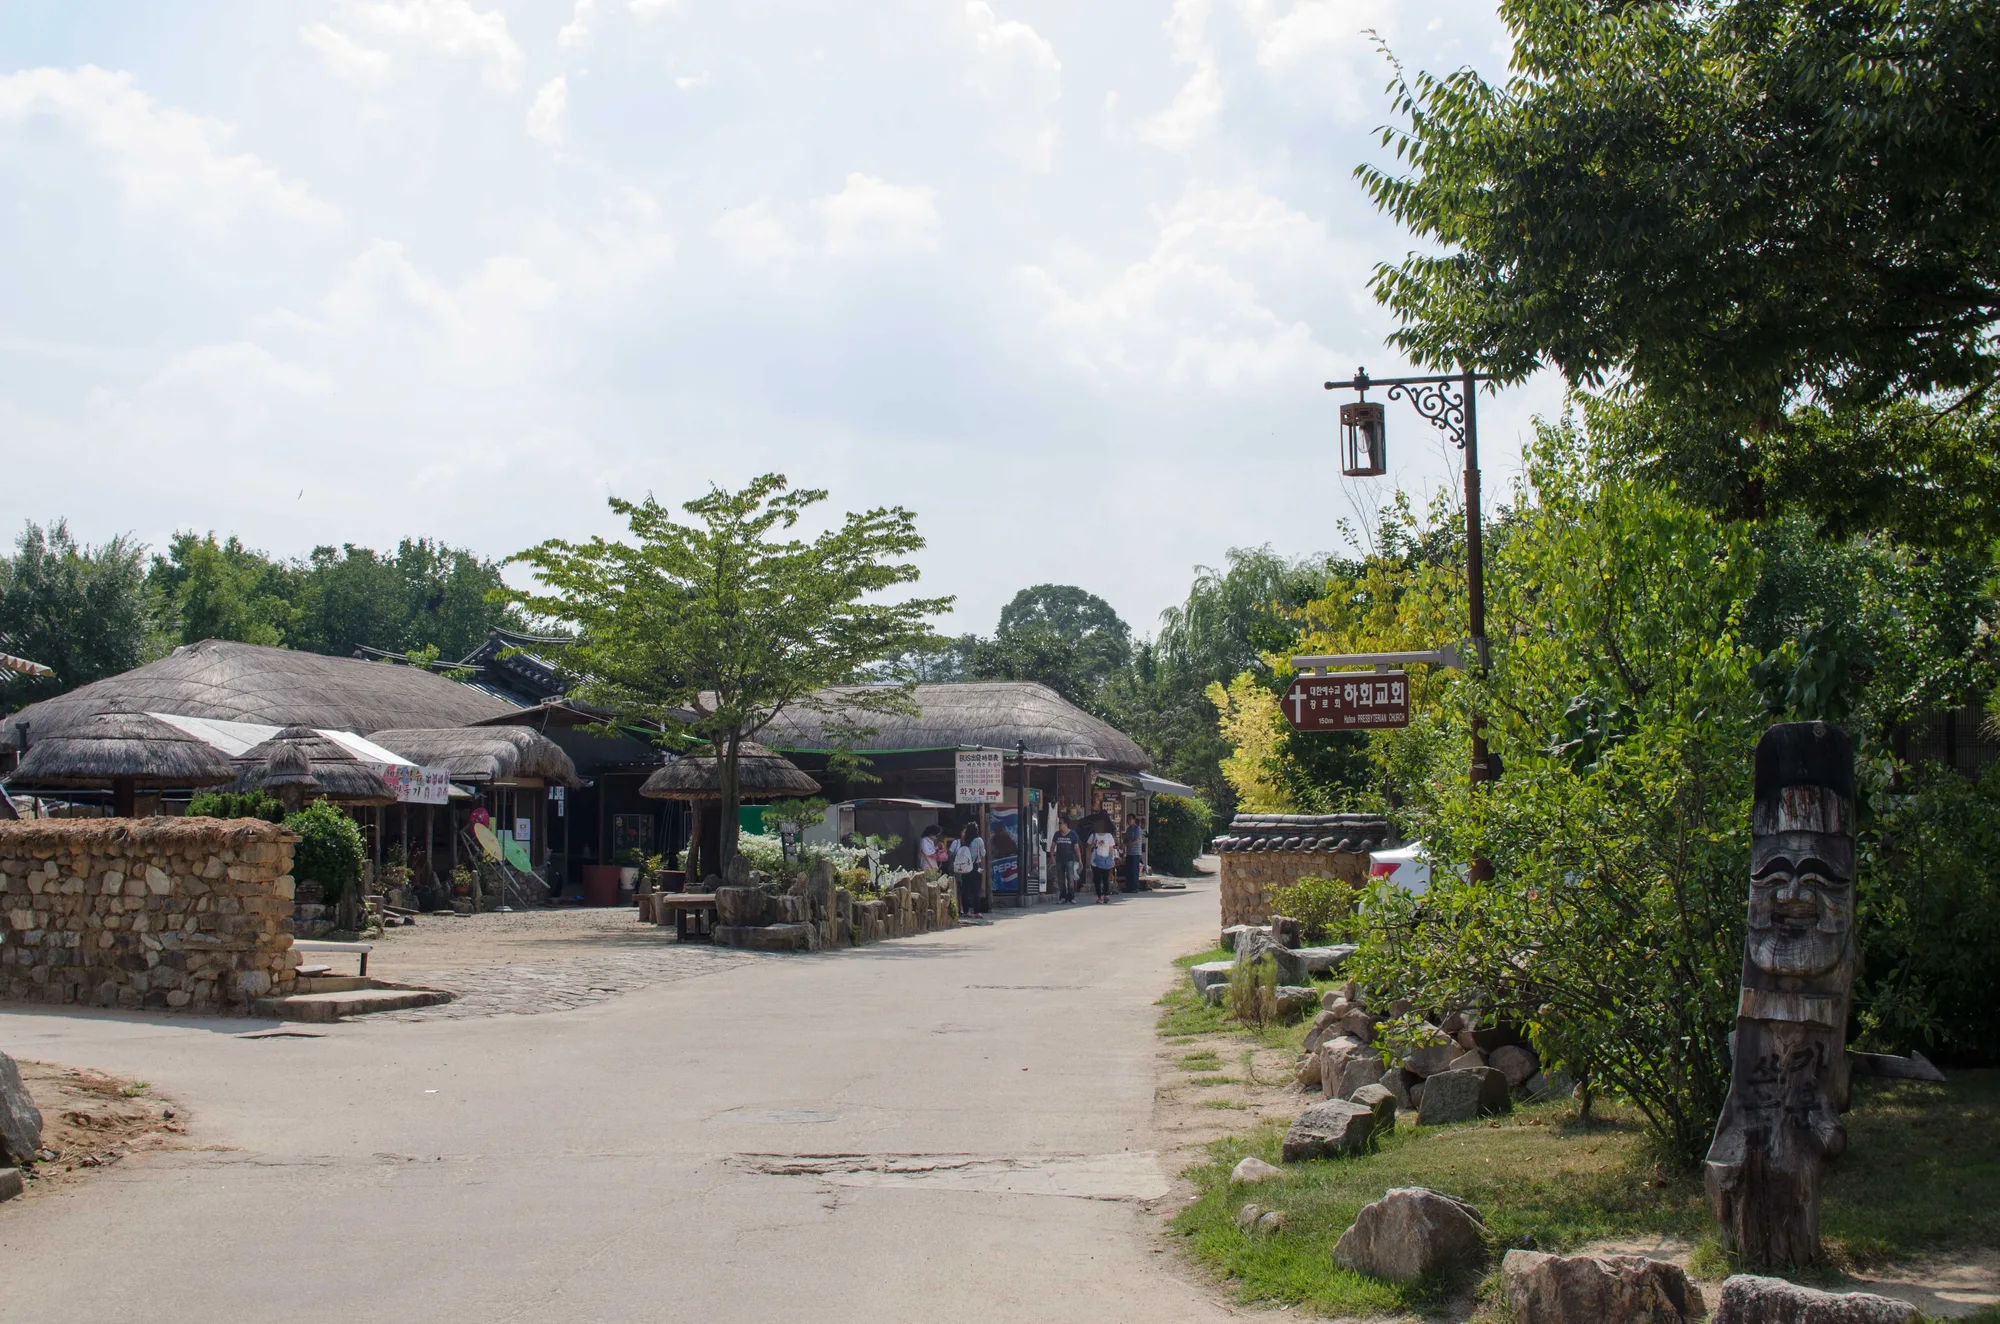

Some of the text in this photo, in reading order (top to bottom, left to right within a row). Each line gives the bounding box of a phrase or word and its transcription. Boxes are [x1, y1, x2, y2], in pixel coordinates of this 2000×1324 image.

[1310, 686, 1340, 696] 대한예수교
[1344, 681, 1404, 708] 하회교회
[1358, 714, 1387, 723] PRESBYTERIAN
[1389, 713, 1405, 722] CHURCH
[960, 788, 985, 796] 화장실
[993, 861, 1018, 874] PEPS
